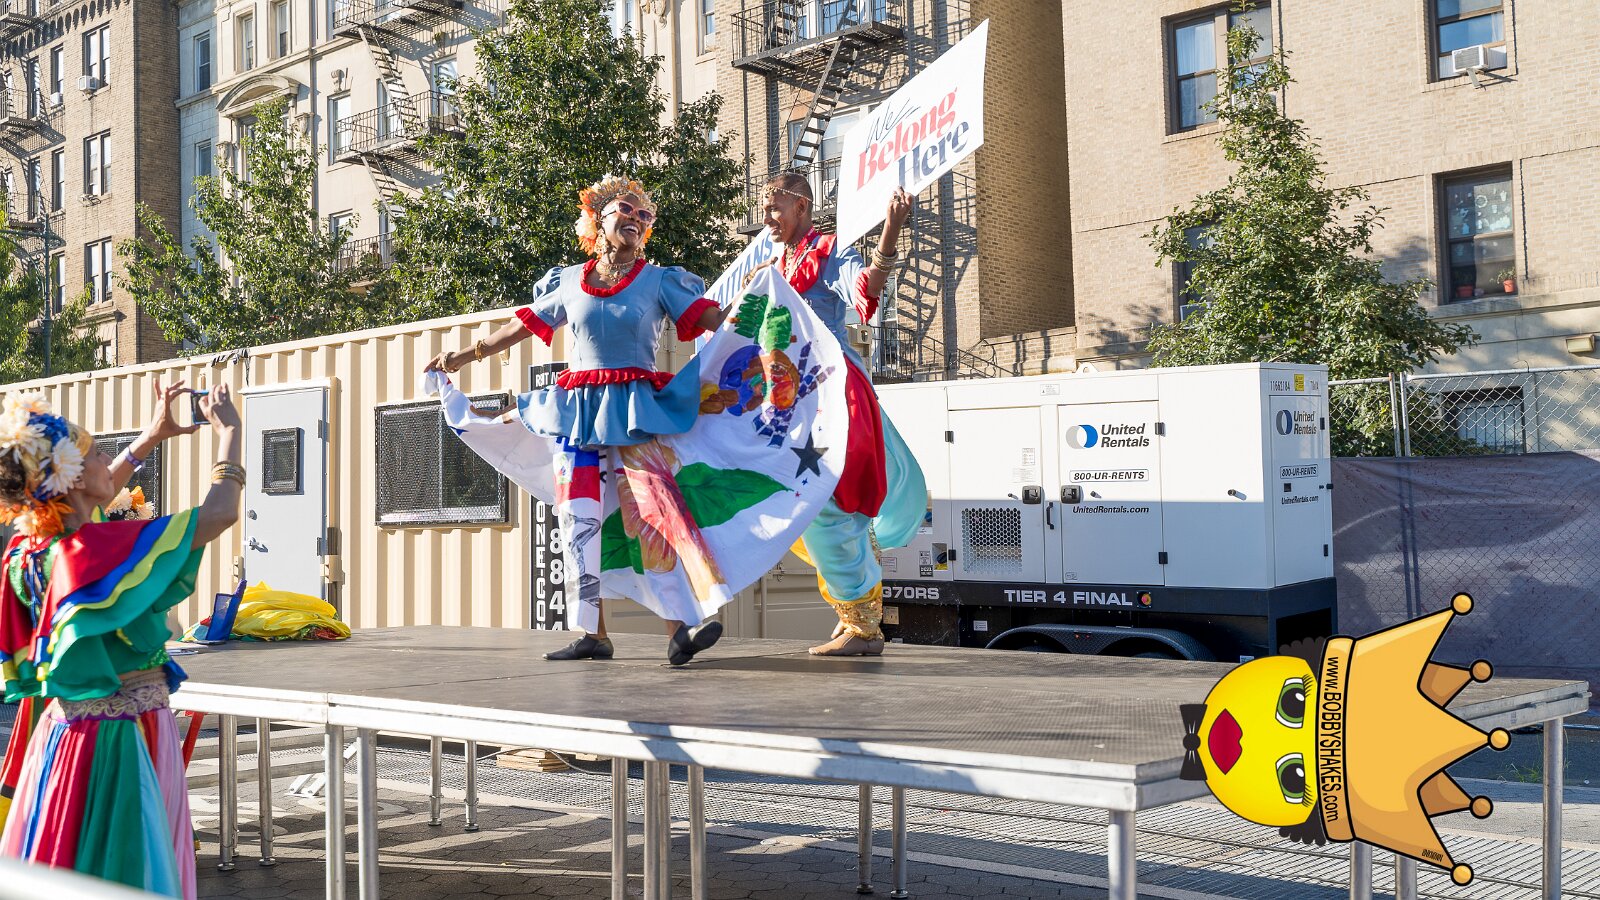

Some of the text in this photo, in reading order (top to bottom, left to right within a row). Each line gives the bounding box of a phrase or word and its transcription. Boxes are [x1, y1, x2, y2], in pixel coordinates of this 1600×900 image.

[866, 97, 920, 153] We
[857, 87, 957, 191] Belong
[898, 121, 969, 189] Here
[713, 232, 773, 311] AITIANS
[1293, 410, 1315, 422] United
[1101, 422, 1146, 435] United
[1293, 423, 1317, 435] Rentals
[1100, 436, 1149, 448] Rentals
[1073, 471, 1145, 480] 800-UR-RENTS
[1281, 466, 1317, 477] 800-UR-RENTS
[1281, 495, 1318, 505] UnitedRentals.com
[1072, 505, 1150, 514] UnitedRentals.com
[1003, 589, 1133, 606] TIER 4 FINAL
